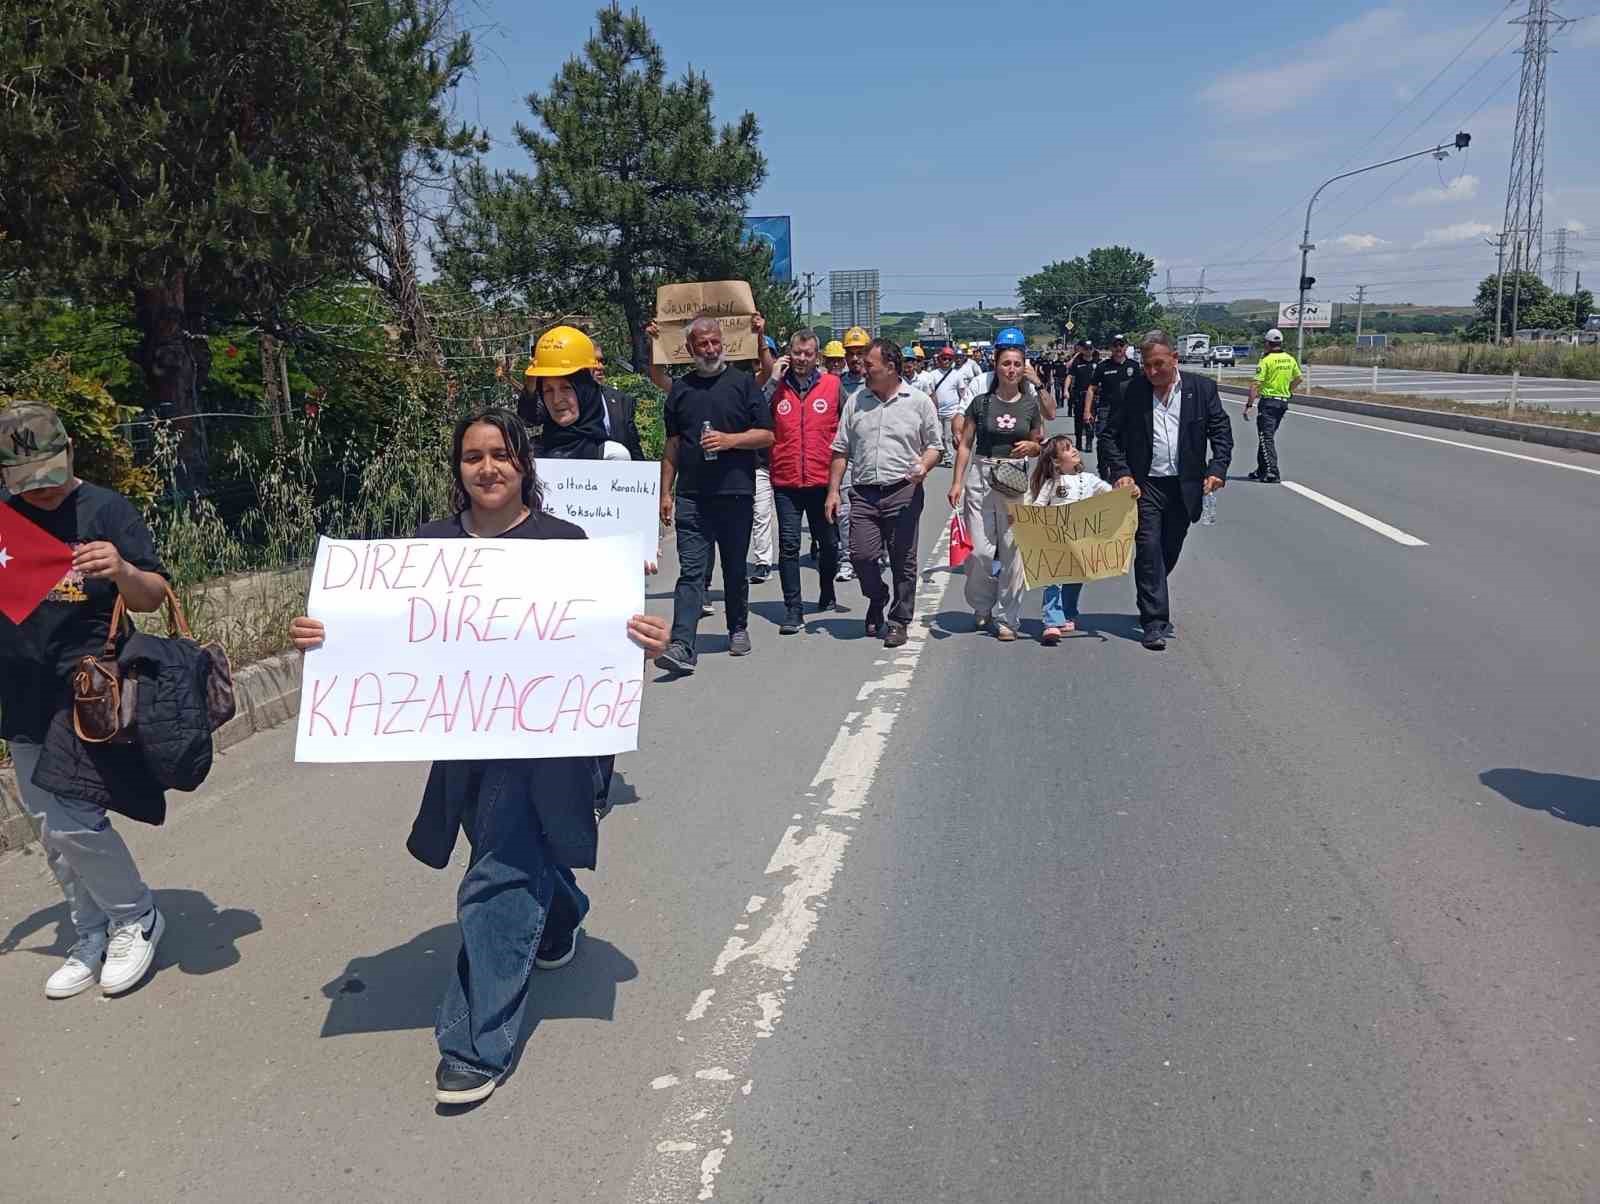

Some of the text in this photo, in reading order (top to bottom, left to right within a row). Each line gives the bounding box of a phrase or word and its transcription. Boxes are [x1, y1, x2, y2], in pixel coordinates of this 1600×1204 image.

[566, 504, 621, 520] Yoksulluk!
[322, 542, 507, 591] DİRENE
[406, 589, 598, 644] DİRENE
[308, 665, 643, 737] KAZANACAĞIZ
